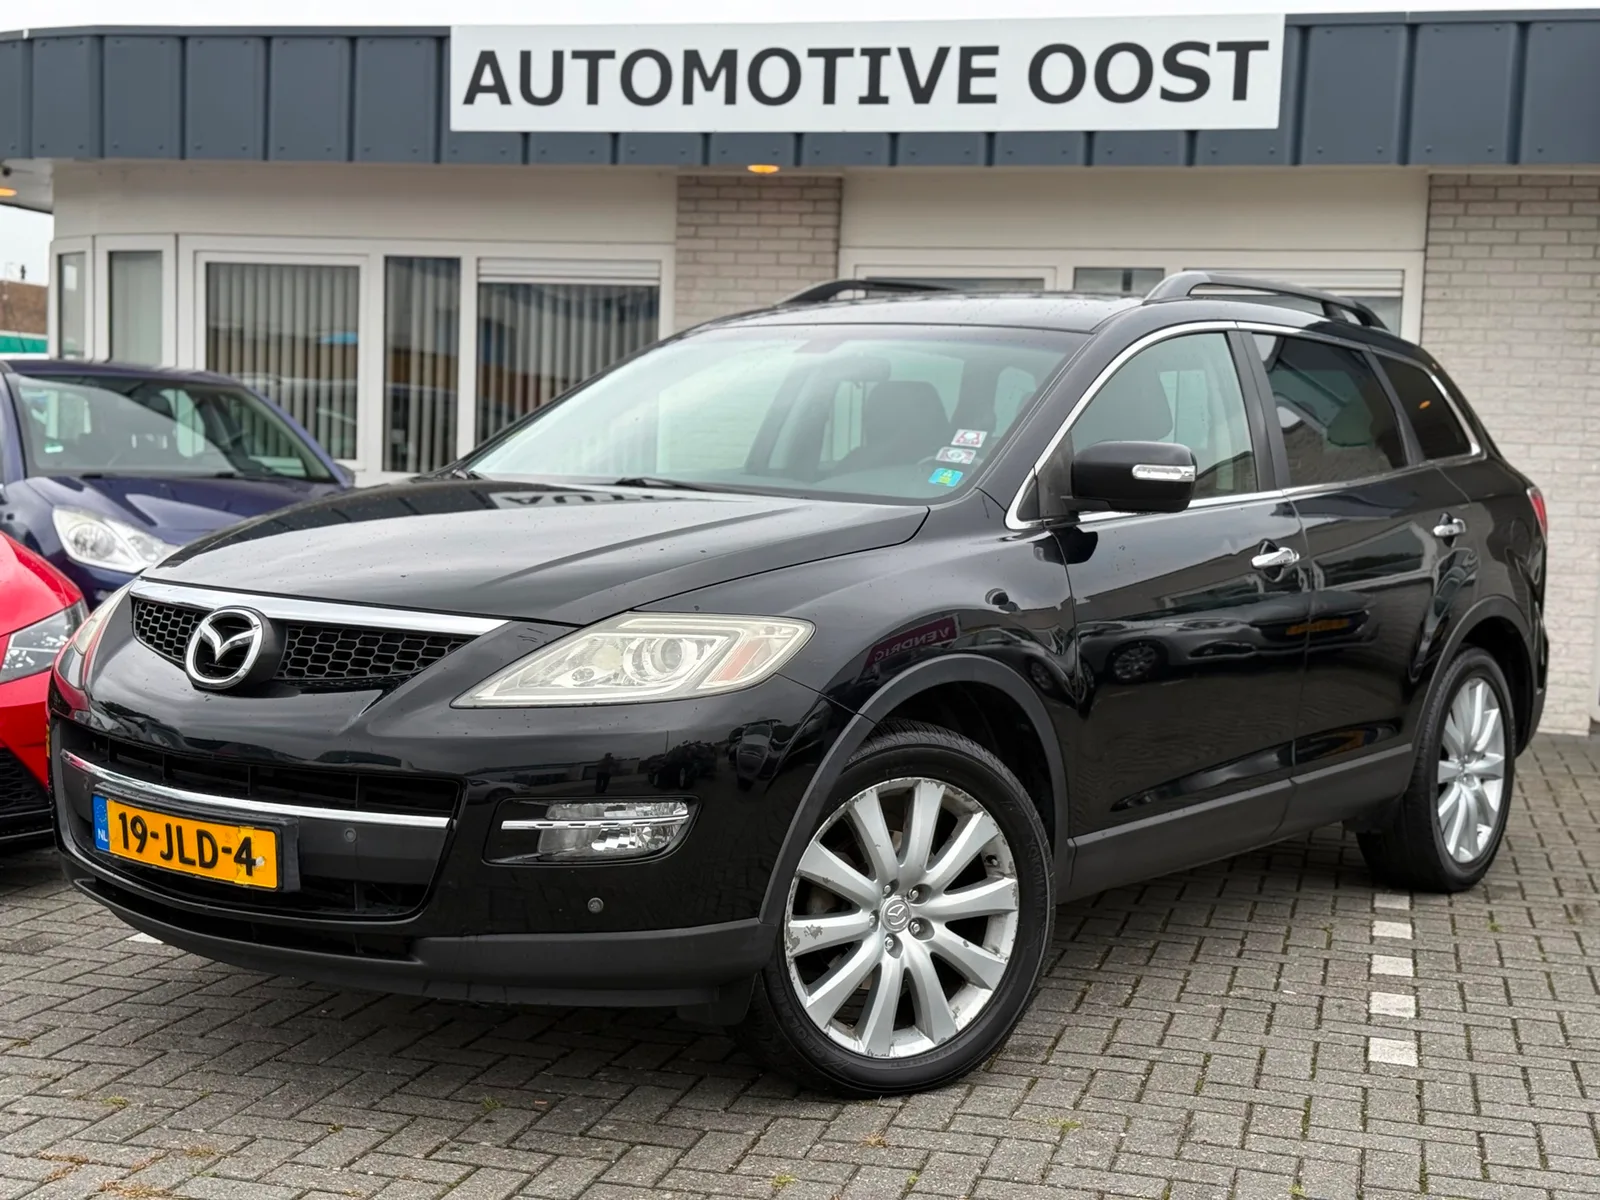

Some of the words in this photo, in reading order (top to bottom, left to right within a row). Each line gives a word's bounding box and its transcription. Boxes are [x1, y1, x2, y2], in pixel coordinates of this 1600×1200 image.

[463, 45, 999, 107] AUTOMOTIVE
[1028, 40, 1270, 105] OOST
[97, 827, 109, 842] NL
[118, 811, 257, 877] 19-JLD-4
